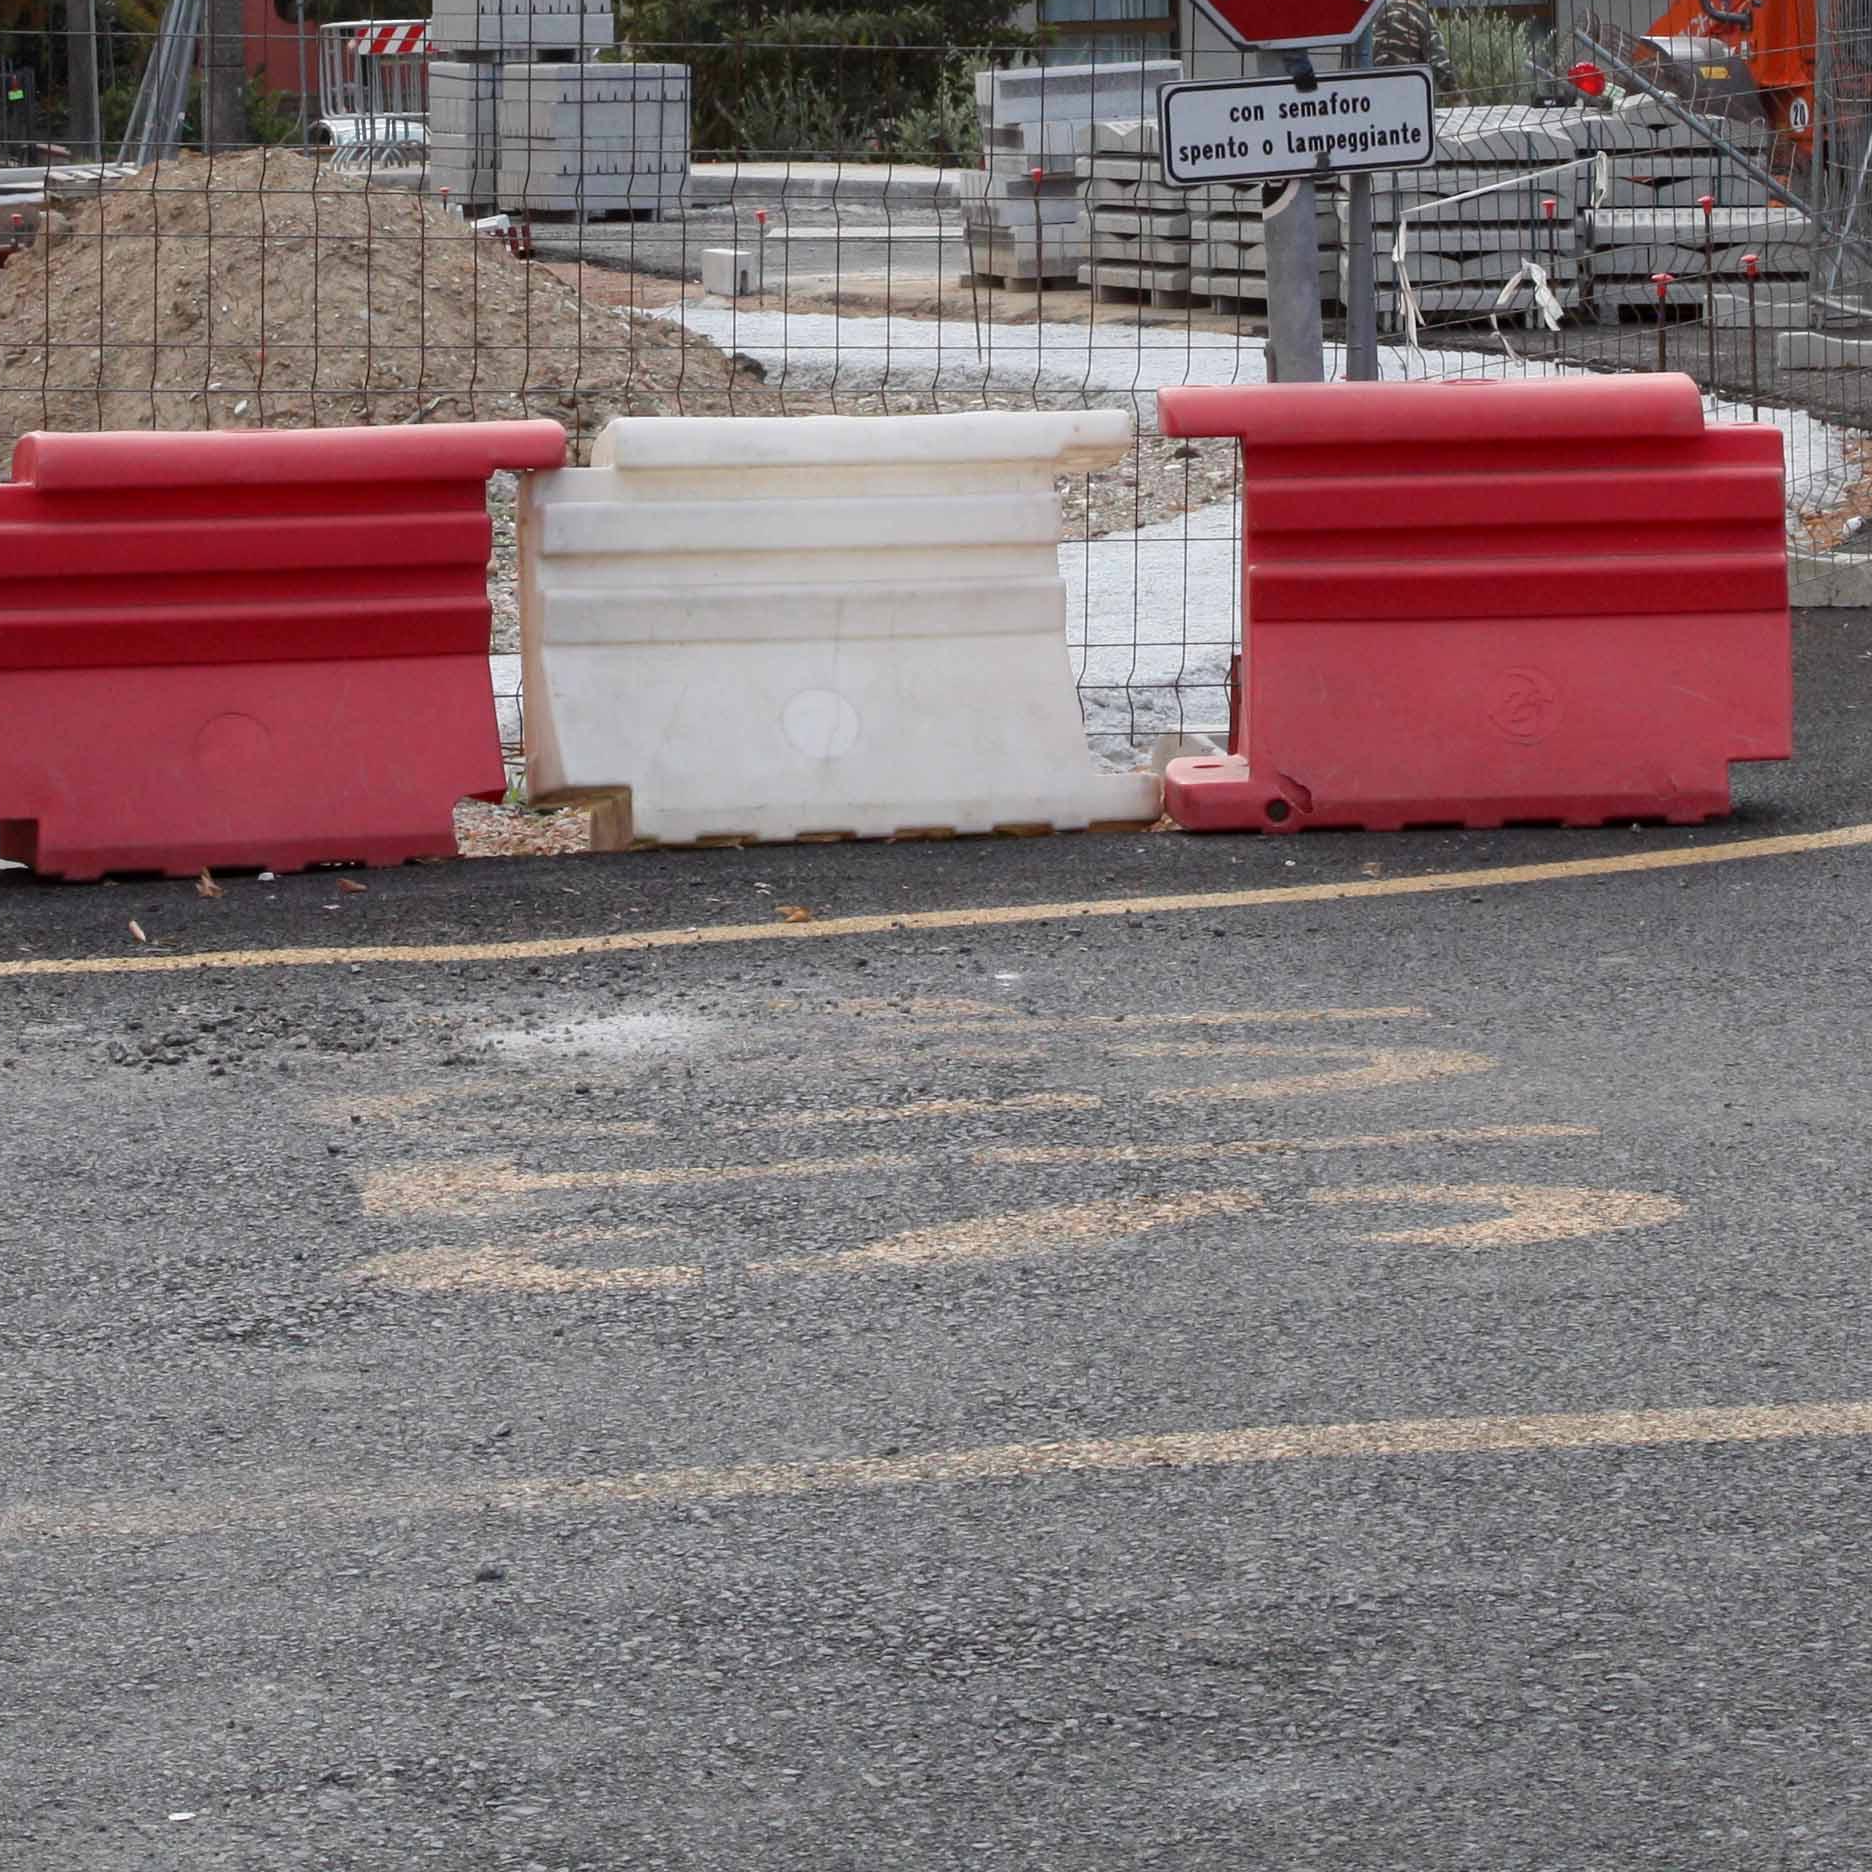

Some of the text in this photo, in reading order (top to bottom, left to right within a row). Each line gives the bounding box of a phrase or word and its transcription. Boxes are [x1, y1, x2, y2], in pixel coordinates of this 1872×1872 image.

[1229, 92, 1371, 123] con semaforo
[1792, 102, 1806, 126] 20
[1179, 122, 1421, 166] spento o lampeggiante
